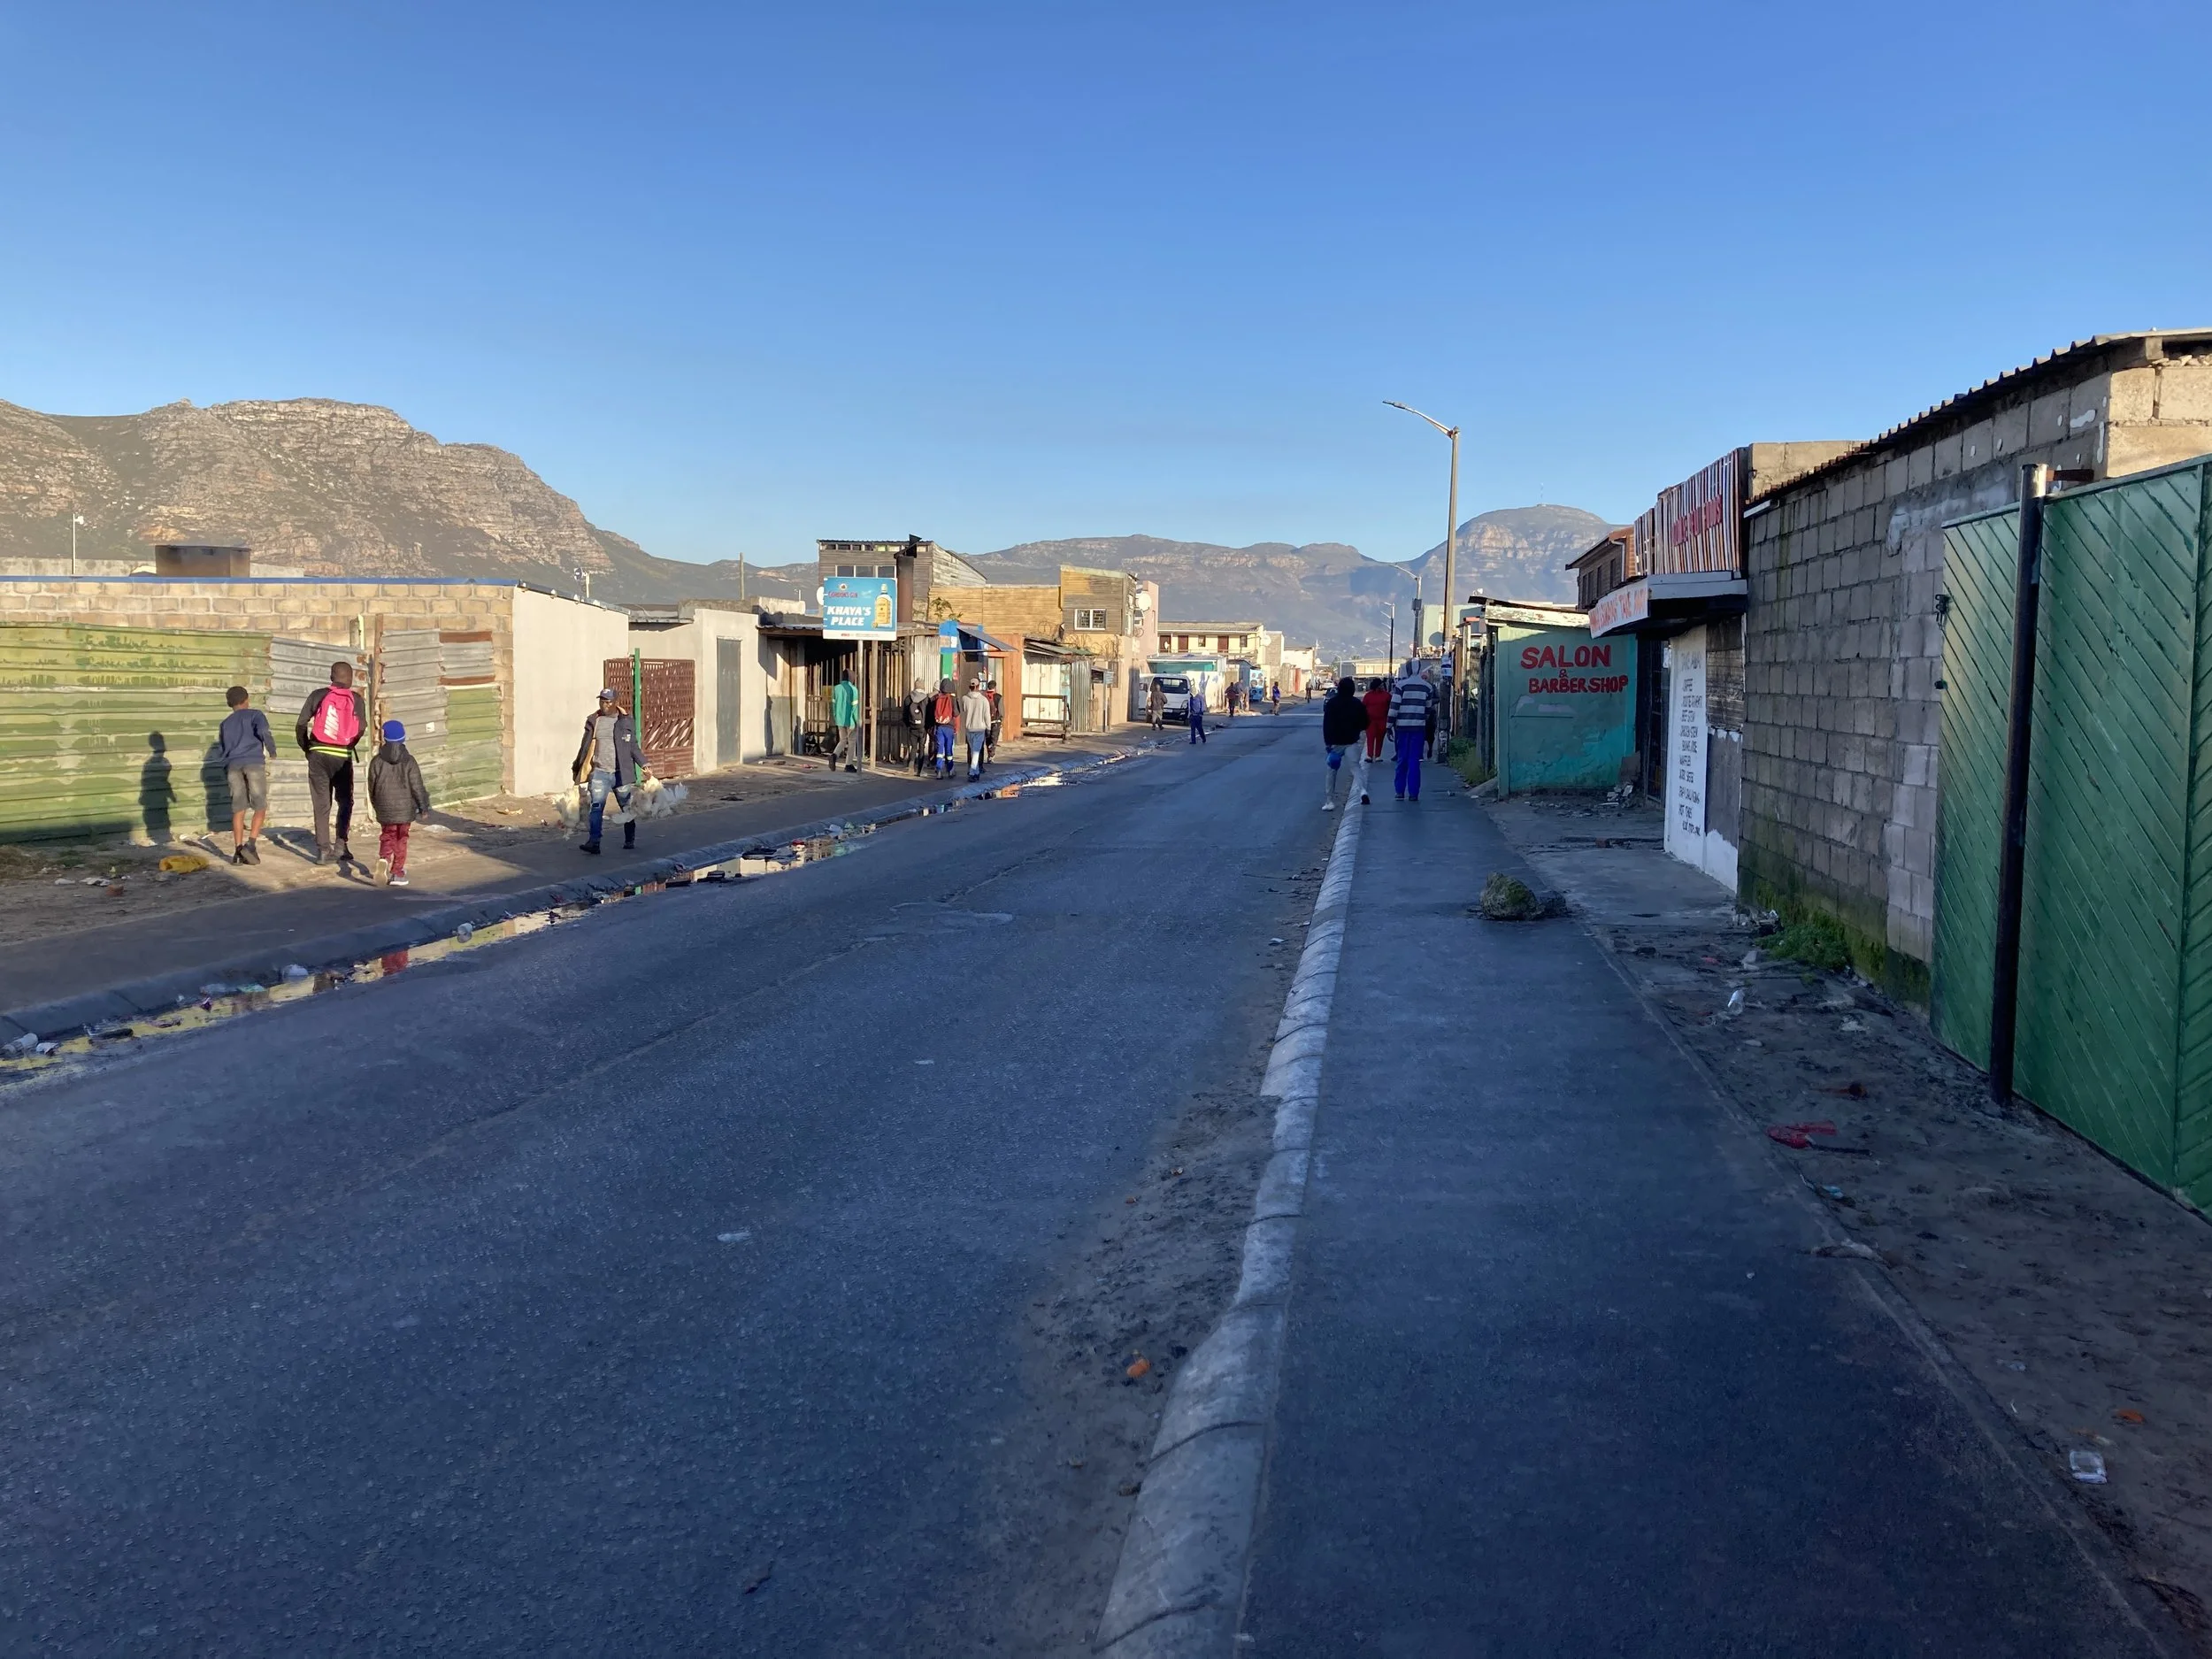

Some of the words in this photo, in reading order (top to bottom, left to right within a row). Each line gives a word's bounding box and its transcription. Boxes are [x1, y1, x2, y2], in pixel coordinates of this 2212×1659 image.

[826, 606, 872, 616] KHAYA'S
[831, 617, 864, 626] PLACE
[1520, 644, 1611, 669] SALON
[1558, 668, 1569, 679] &
[324, 704, 339, 741] NIKE
